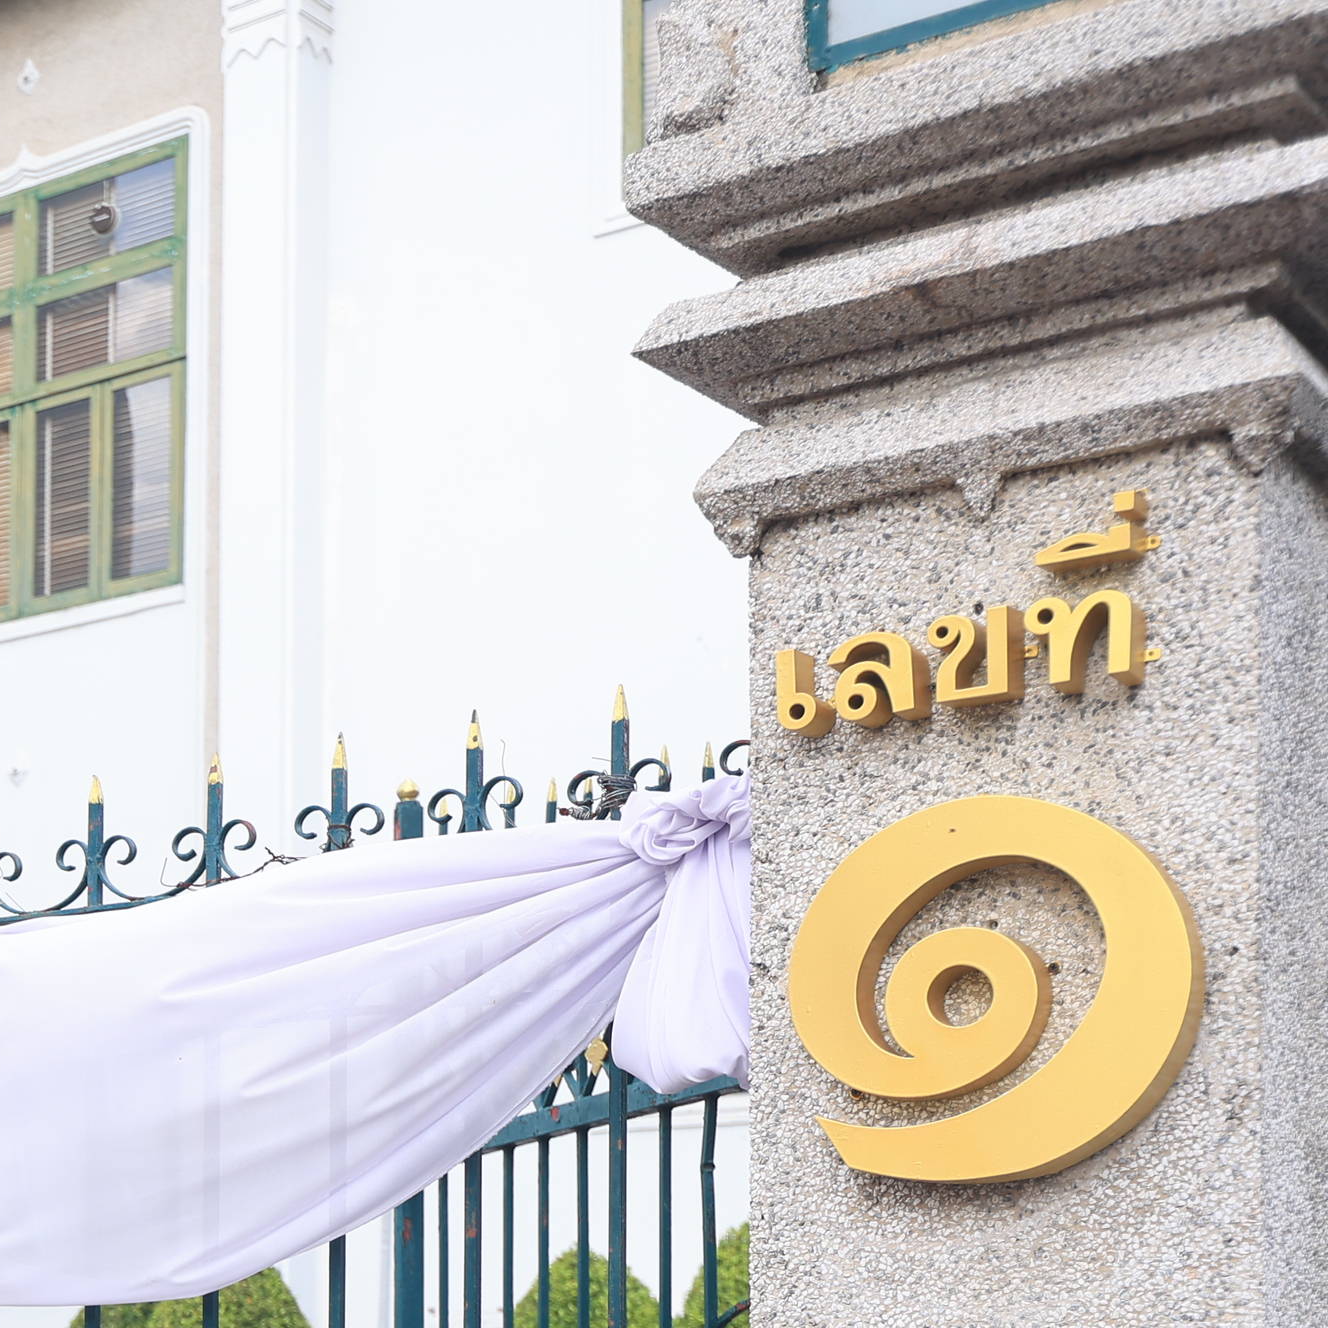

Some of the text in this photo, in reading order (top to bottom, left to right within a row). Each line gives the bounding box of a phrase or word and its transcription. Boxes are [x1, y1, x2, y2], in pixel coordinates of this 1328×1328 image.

[775, 489, 1150, 737] เลขที่
[788, 794, 1206, 1185] ๑
